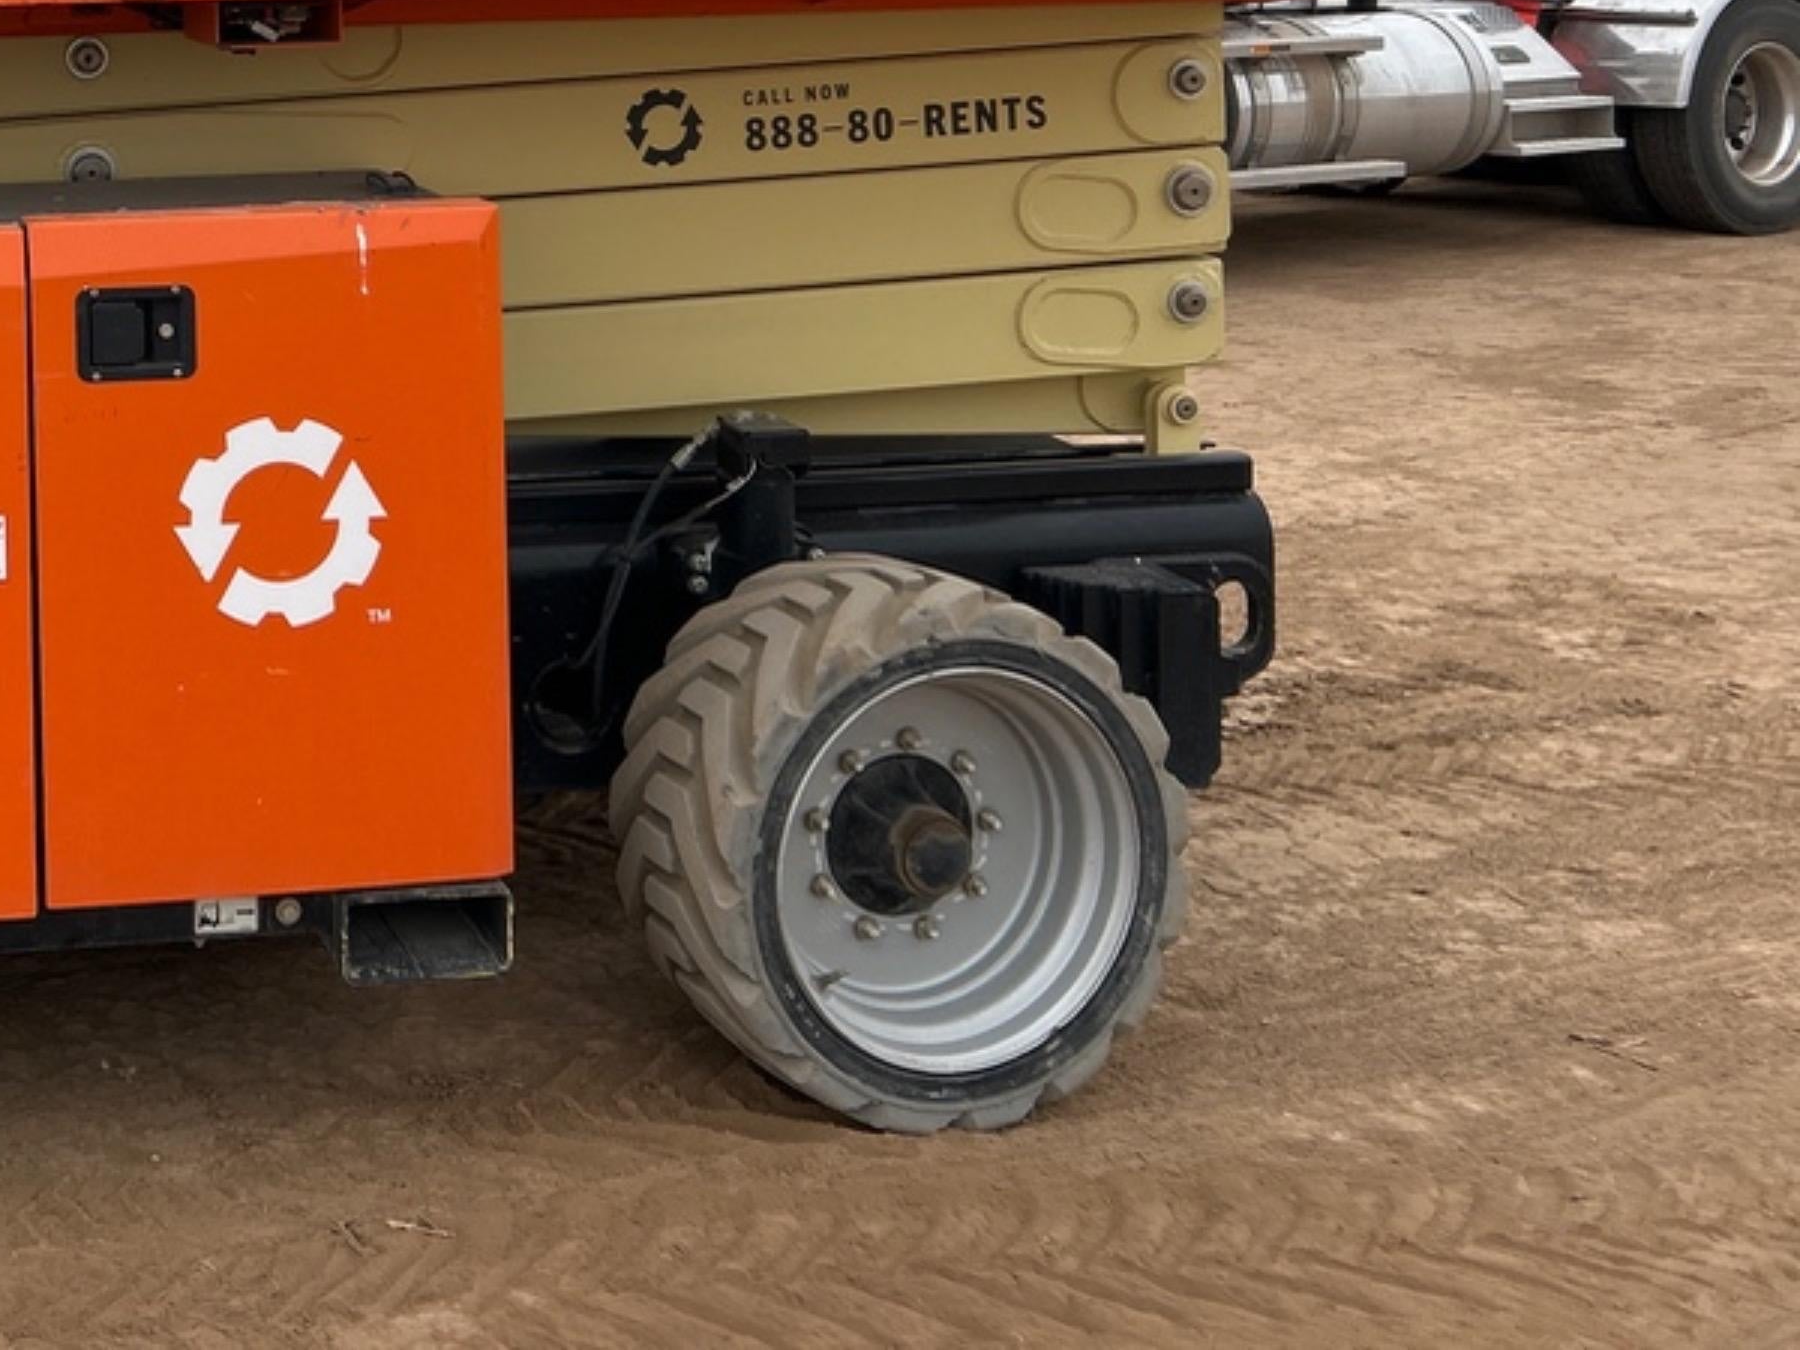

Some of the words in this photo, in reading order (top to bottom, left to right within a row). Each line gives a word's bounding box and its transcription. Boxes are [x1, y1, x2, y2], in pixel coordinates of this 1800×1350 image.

[742, 88, 795, 107] CALL
[803, 81, 851, 103] NOW
[743, 94, 1050, 152] 888-80-RENTS
